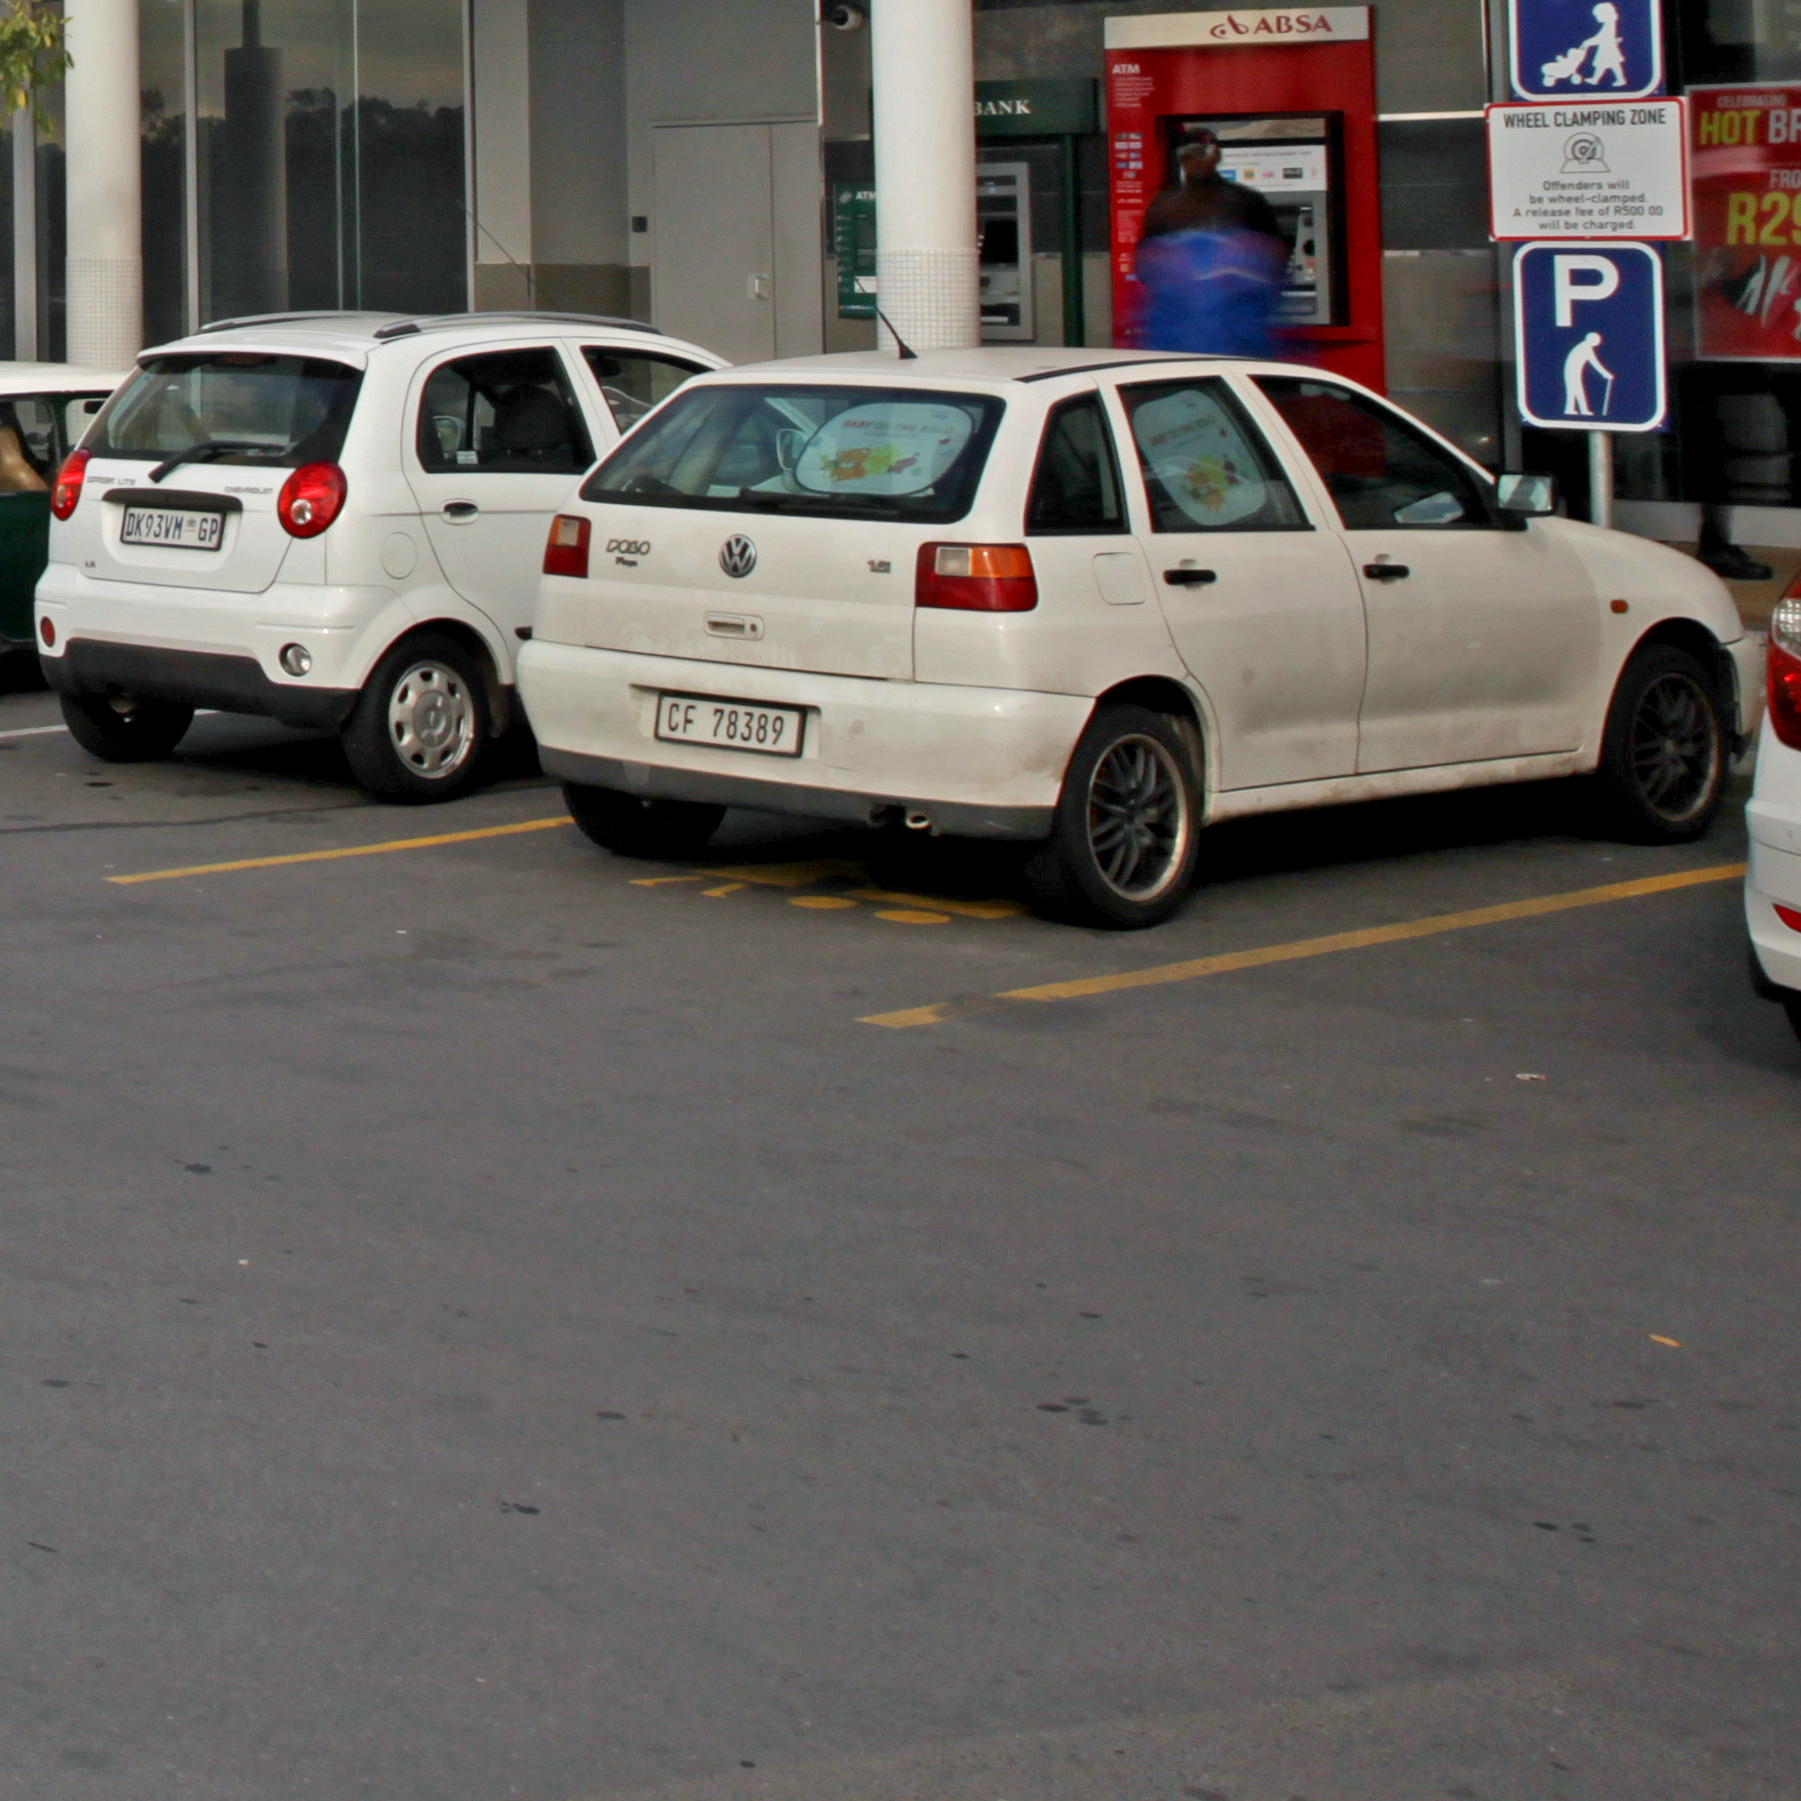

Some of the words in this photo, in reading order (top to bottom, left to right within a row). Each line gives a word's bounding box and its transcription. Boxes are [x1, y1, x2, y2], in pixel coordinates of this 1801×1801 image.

[1253, 14, 1333, 34] ABSA
[1111, 63, 1141, 75] ATM
[1503, 112, 1550, 128] WHEEL
[1554, 110, 1626, 127] CLAMPING
[1630, 108, 1667, 125] ZONE
[1700, 110, 1761, 145] HOT
[1542, 180, 1603, 191] Offenders
[1607, 180, 1631, 190] will
[1528, 194, 1543, 205] be
[1512, 208, 1522, 218] A
[1525, 206, 1571, 217] release
[1574, 205, 1594, 216] fee
[1598, 205, 1611, 216] of
[1538, 220, 1561, 230] will
[1564, 219, 1579, 230] be
[1554, 254, 1620, 327] P
[126, 512, 184, 541] DK93VM
[198, 516, 219, 543] GP
[667, 703, 697, 734] CF
[712, 707, 785, 746] 78389
